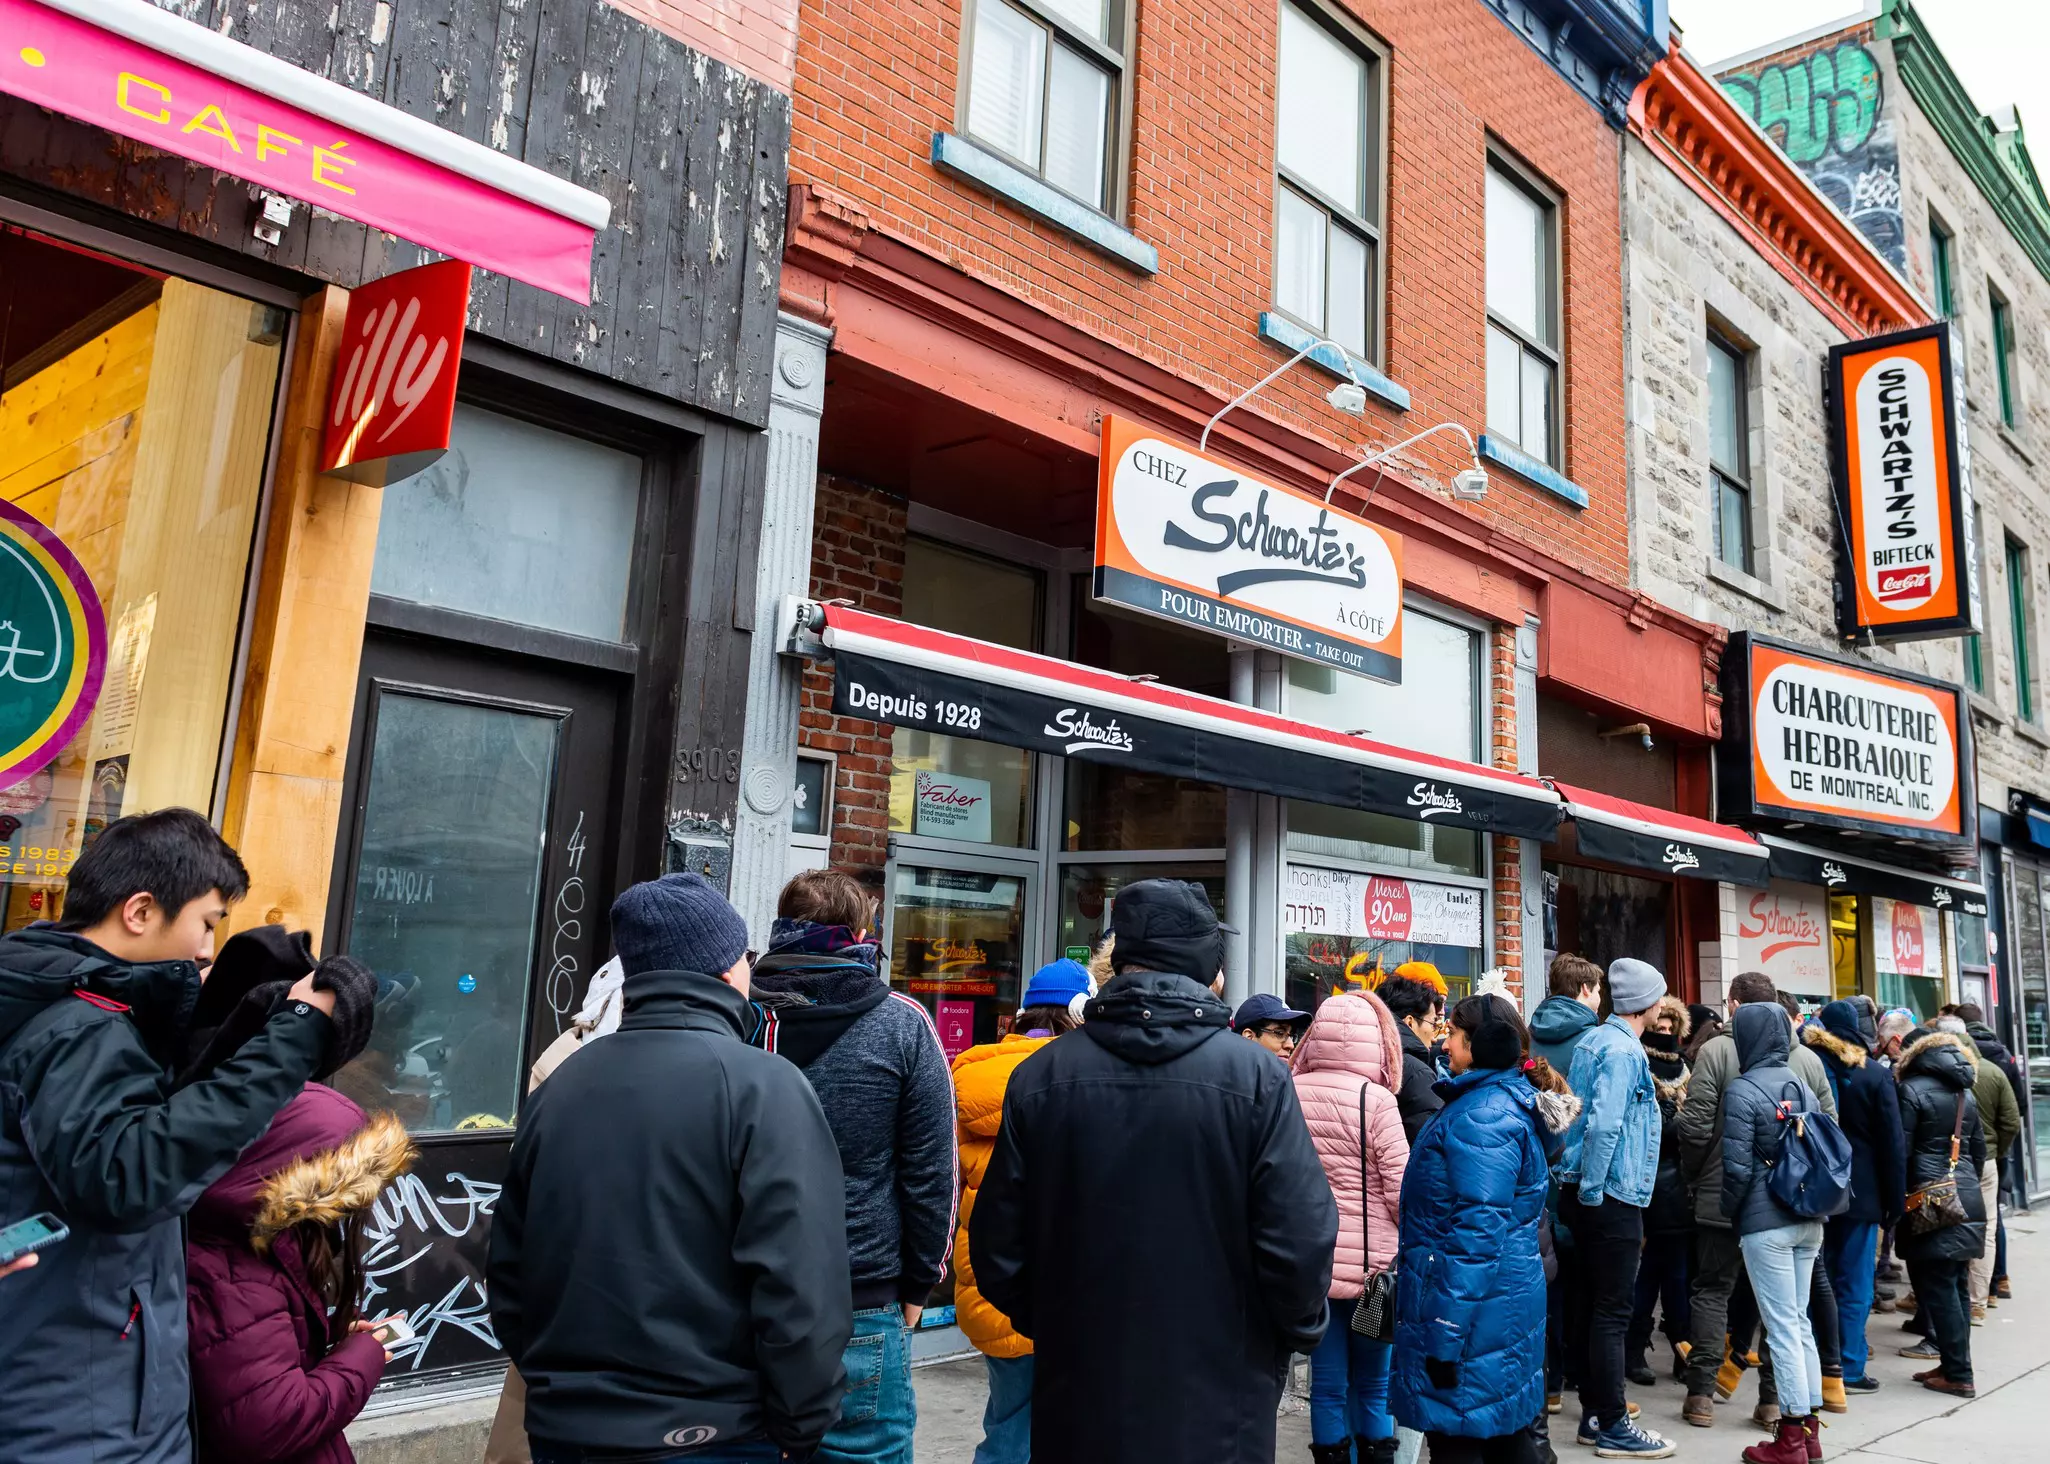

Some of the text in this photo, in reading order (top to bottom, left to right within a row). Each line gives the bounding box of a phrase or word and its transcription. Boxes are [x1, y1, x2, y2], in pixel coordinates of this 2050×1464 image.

[116, 71, 357, 195] CAFÉ
[334, 297, 448, 442] illy
[1133, 451, 1187, 488] CHEZ
[1878, 368, 1917, 539] SCHWARTZ'S
[1164, 480, 1366, 597] Schwartz's
[1873, 543, 1935, 566] BIFTECK
[1160, 589, 1211, 622] POUR
[1215, 606, 1303, 650] EMPORTER
[1315, 642, 1340, 662] TAKE
[1342, 651, 1363, 668] OUT
[1336, 602, 1384, 637] À CÔTÉ
[850, 682, 982, 730] Depuis 1928
[1772, 679, 1938, 746] CHARCUTERIE
[1044, 708, 1132, 754] Schwartz's
[677, 747, 741, 784] 3903
[1783, 726, 1934, 787] HEBRAIQUE
[920, 784, 982, 807] Faber
[920, 801, 968, 815] Fabricant de stores
[1407, 782, 1462, 818] Schwartz's
[1791, 770, 1934, 812] DE MONTRÉAL INC.
[920, 808, 969, 821] Blind manufacturer
[20, 846, 75, 862] 1983
[35, 863, 73, 877] 198
[1286, 865, 1331, 889] Thanks!
[1371, 879, 1405, 899] Merci!
[1370, 899, 1394, 925] 90
[1392, 911, 1407, 923] ans
[1739, 891, 1821, 964] Schwartz's
[1896, 930, 1912, 960] 90
[911, 982, 929, 990] POUR
[930, 983, 962, 991] EMPORTER
